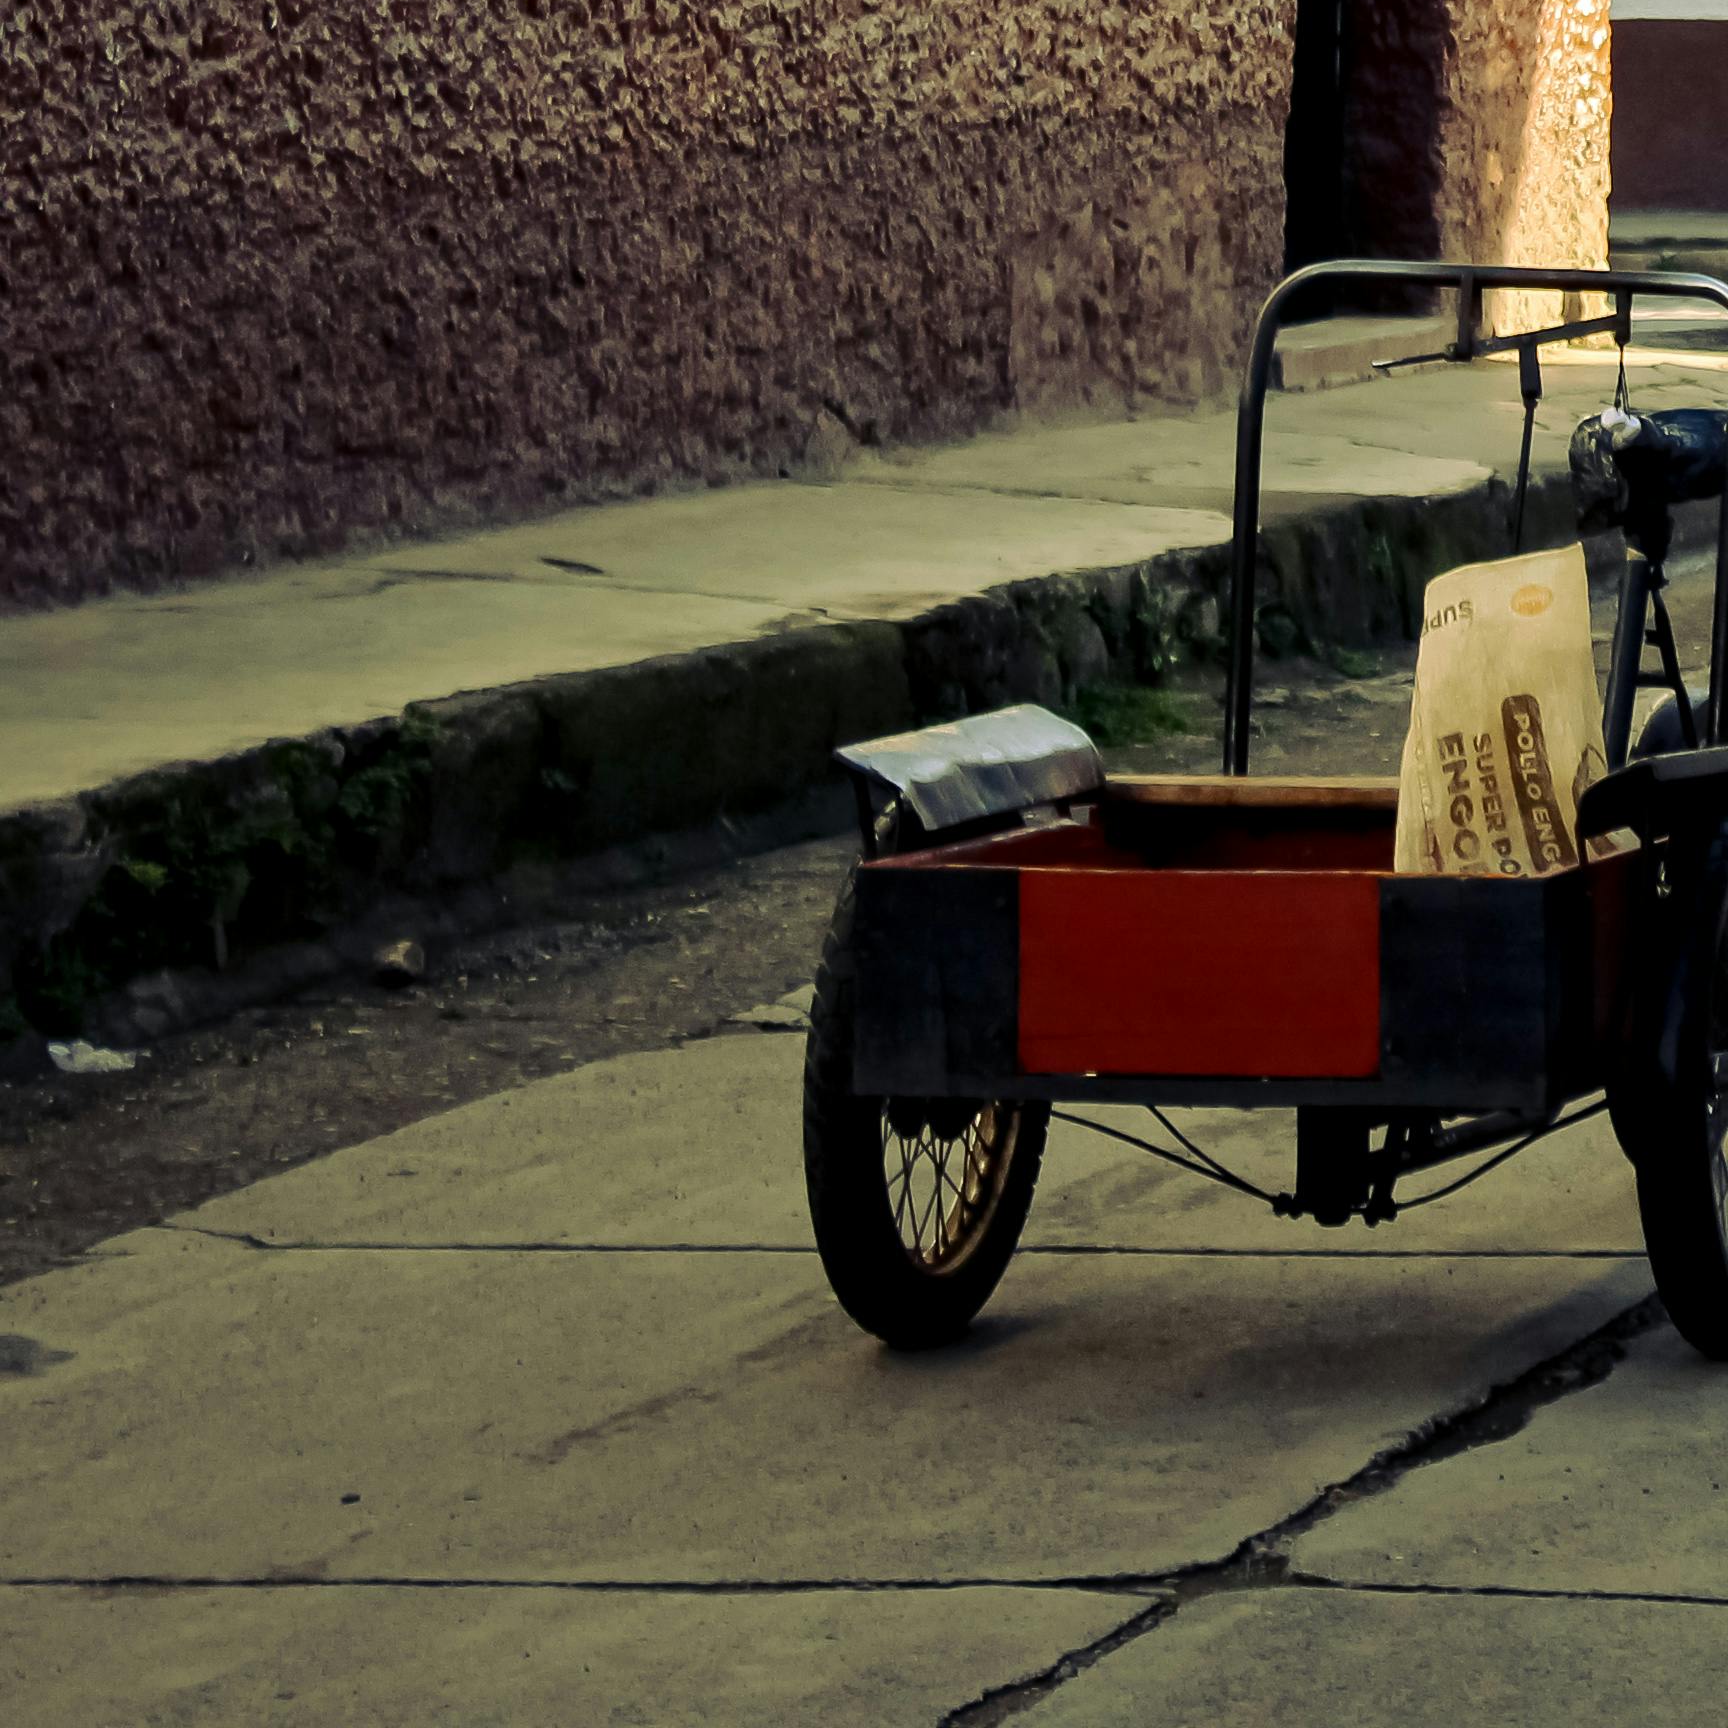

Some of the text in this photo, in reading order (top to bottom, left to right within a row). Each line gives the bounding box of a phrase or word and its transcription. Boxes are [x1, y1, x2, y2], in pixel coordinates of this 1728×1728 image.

[1473, 733, 1527, 876] SUPER PO
[1513, 712, 1564, 869] POLLO ENG
